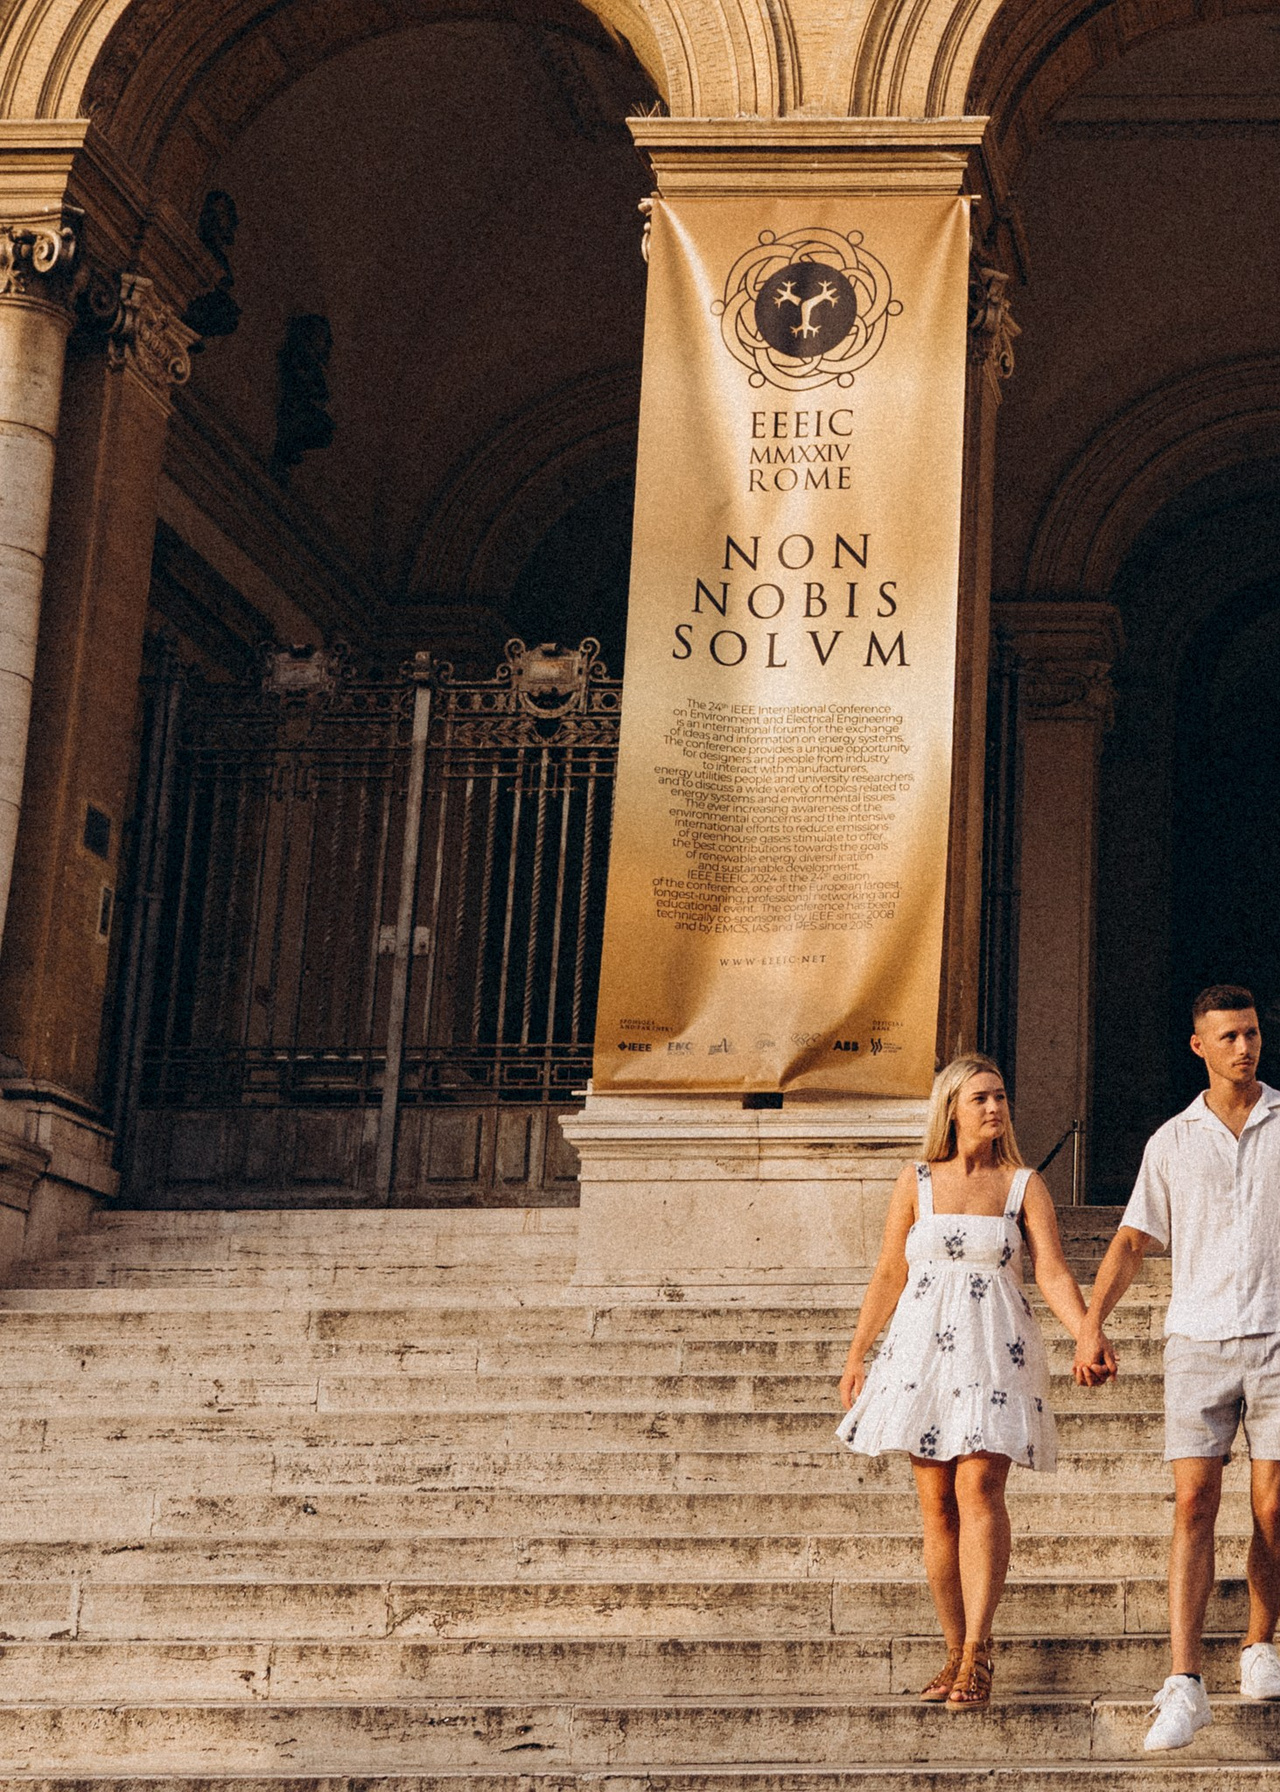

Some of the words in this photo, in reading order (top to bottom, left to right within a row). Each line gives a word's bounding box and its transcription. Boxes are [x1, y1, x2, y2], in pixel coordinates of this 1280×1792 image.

[750, 408, 855, 439] EEEIC
[749, 443, 852, 465] MMXXIV
[748, 466, 852, 493] ROME
[722, 532, 872, 571] NON
[691, 577, 898, 620] NOBIS
[672, 623, 911, 668] SOLVM
[687, 698, 706, 708] The
[731, 704, 756, 715] IEEE
[759, 704, 826, 715] International
[828, 703, 892, 714] Conference
[673, 708, 688, 717] on
[690, 709, 760, 724] Environment
[763, 714, 783, 724] and
[786, 714, 834, 724] Electrical
[836, 715, 903, 725] Engineering
[687, 720, 700, 728] an
[702, 721, 770, 734] international
[773, 725, 806, 734] forum
[808, 724, 822, 734] for
[825, 724, 843, 733] the
[845, 724, 900, 735] exchange
[670, 727, 681, 736] of
[683, 728, 711, 740] ideas
[712, 732, 734, 743] and
[736, 734, 799, 744] information
[801, 736, 815, 744] on
[818, 735, 857, 746] energy
[663, 735, 684, 747] The
[685, 739, 746, 754] conference
[748, 744, 794, 756] provides
[805, 744, 844, 754] unique
[846, 743, 910, 755] opportunity
[682, 747, 697, 758] for
[699, 750, 752, 764] designers
[754, 755, 775, 764] and
[777, 754, 815, 765] people
[817, 754, 843, 764] from
[845, 753, 890, 765] industry
[654, 765, 692, 779] energy
[694, 768, 733, 783] utilities
[734, 774, 772, 785] people
[774, 773, 795, 783] and
[798, 773, 850, 785] university
[703, 761, 714, 770] to
[716, 762, 758, 774] interact
[760, 764, 784, 774] with
[658, 775, 679, 786] and
[682, 778, 694, 788] to
[695, 779, 735, 793] discuss
[745, 783, 772, 794] wide
[774, 783, 810, 795] variety
[812, 783, 823, 793] of
[825, 783, 857, 794] topics
[859, 782, 897, 793] related
[899, 782, 910, 792] to
[671, 788, 709, 801] energy
[710, 792, 756, 803] systems
[758, 794, 779, 804] and
[781, 793, 860, 803] environmental
[685, 798, 705, 809] The
[707, 801, 731, 812] ever
[732, 802, 789, 815] increasing
[791, 804, 849, 813] awareness
[850, 802, 862, 812] of
[863, 802, 882, 812] the
[669, 807, 749, 824] environmental
[751, 813, 801, 824] concerns
[803, 813, 825, 823] and
[827, 813, 846, 823] the
[848, 812, 896, 823] intensive
[674, 817, 744, 833] international
[782, 824, 794, 833] to
[796, 823, 834, 833] reduce
[836, 822, 889, 833] emissions
[751, 873, 777, 884] 2024
[790, 872, 808, 883] the
[832, 872, 870, 882] edition
[628, 1042, 652, 1052] IEEE
[833, 1040, 859, 1052] ABB
